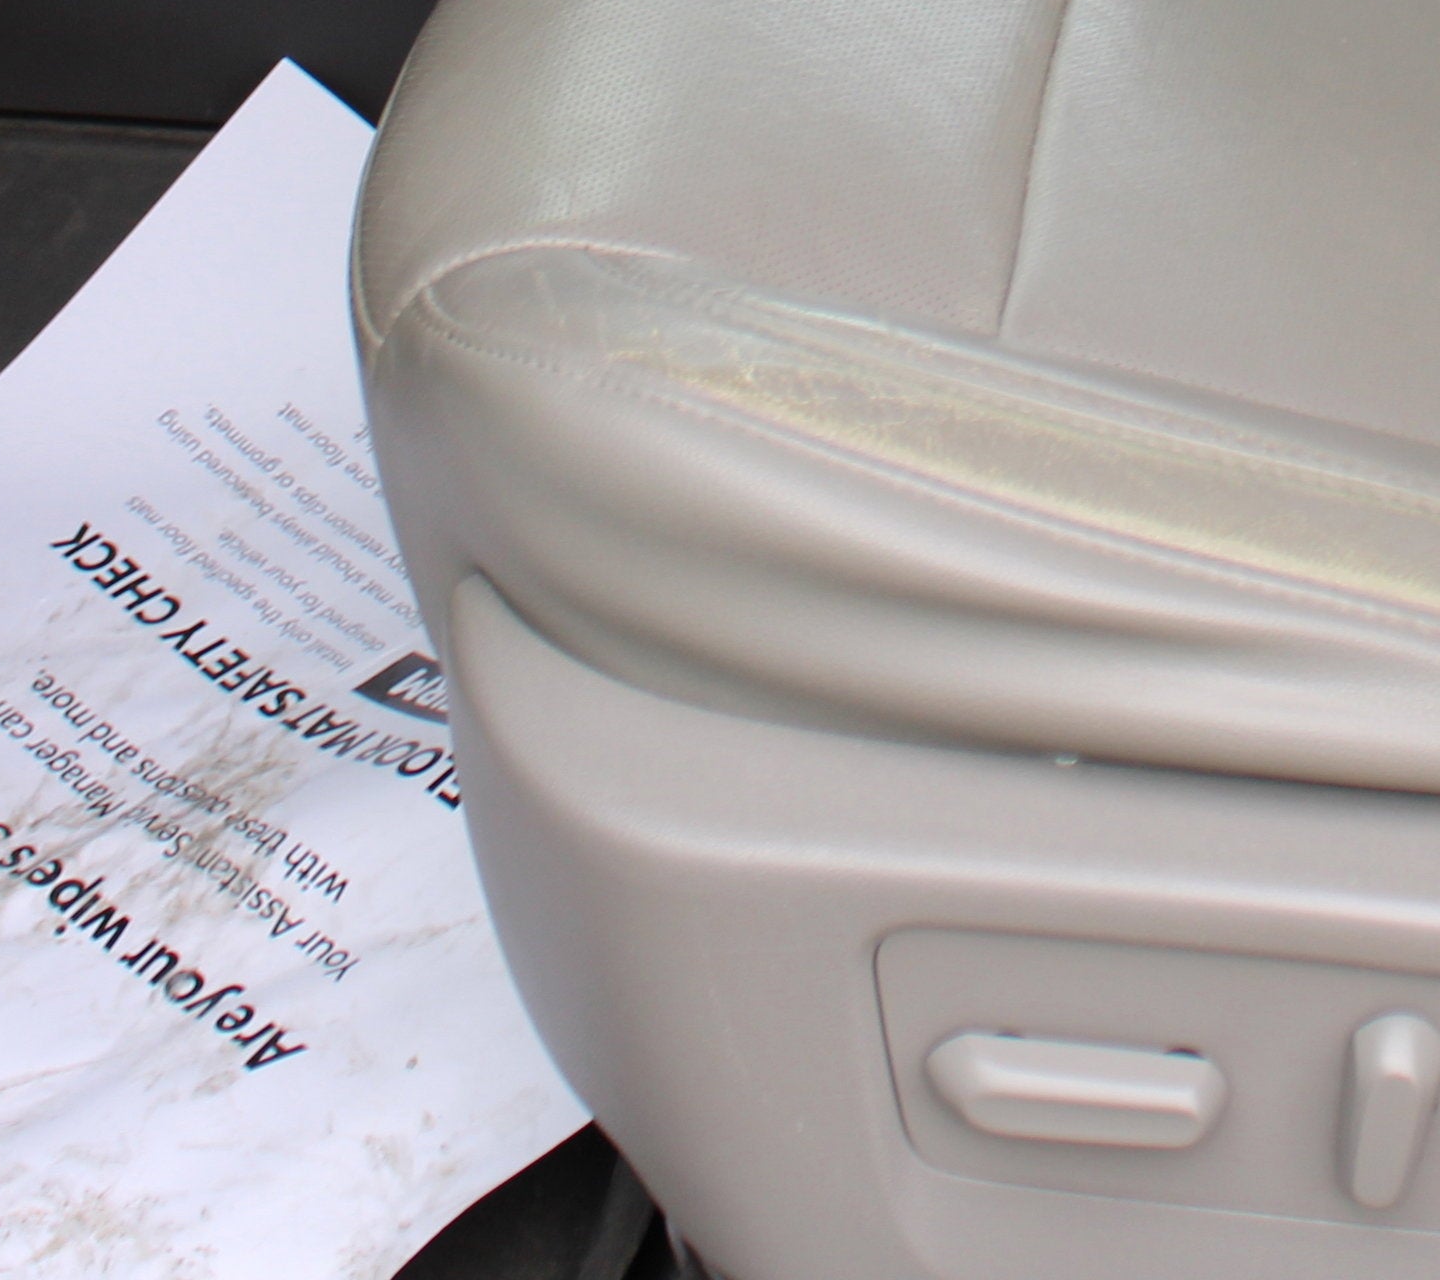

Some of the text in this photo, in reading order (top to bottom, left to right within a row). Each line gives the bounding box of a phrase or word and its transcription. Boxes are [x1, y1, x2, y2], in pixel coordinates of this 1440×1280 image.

[157, 409, 201, 453] using
[205, 407, 280, 473] grommets.
[277, 402, 311, 433] mat
[307, 431, 348, 467] floor
[191, 450, 255, 500] secured
[272, 471, 295, 488] or
[344, 462, 382, 489] one
[249, 496, 275, 519] be
[291, 486, 328, 515] clips
[323, 512, 389, 558] retention
[125, 496, 354, 674] Install only the specified floor mats
[308, 543, 367, 584] should
[217, 531, 386, 652] designed for your vehicle.
[359, 579, 394, 605] mat
[51, 523, 459, 810] FLOOR MAT SAFETY CHECK
[27, 671, 95, 728] more.
[78, 722, 139, 764] and
[25, 739, 126, 819] Manager
[188, 847, 303, 938] Assistan
[284, 843, 348, 902] with
[119, 939, 244, 1018] your
[295, 931, 359, 982] Your
[215, 1005, 305, 1070] Are
